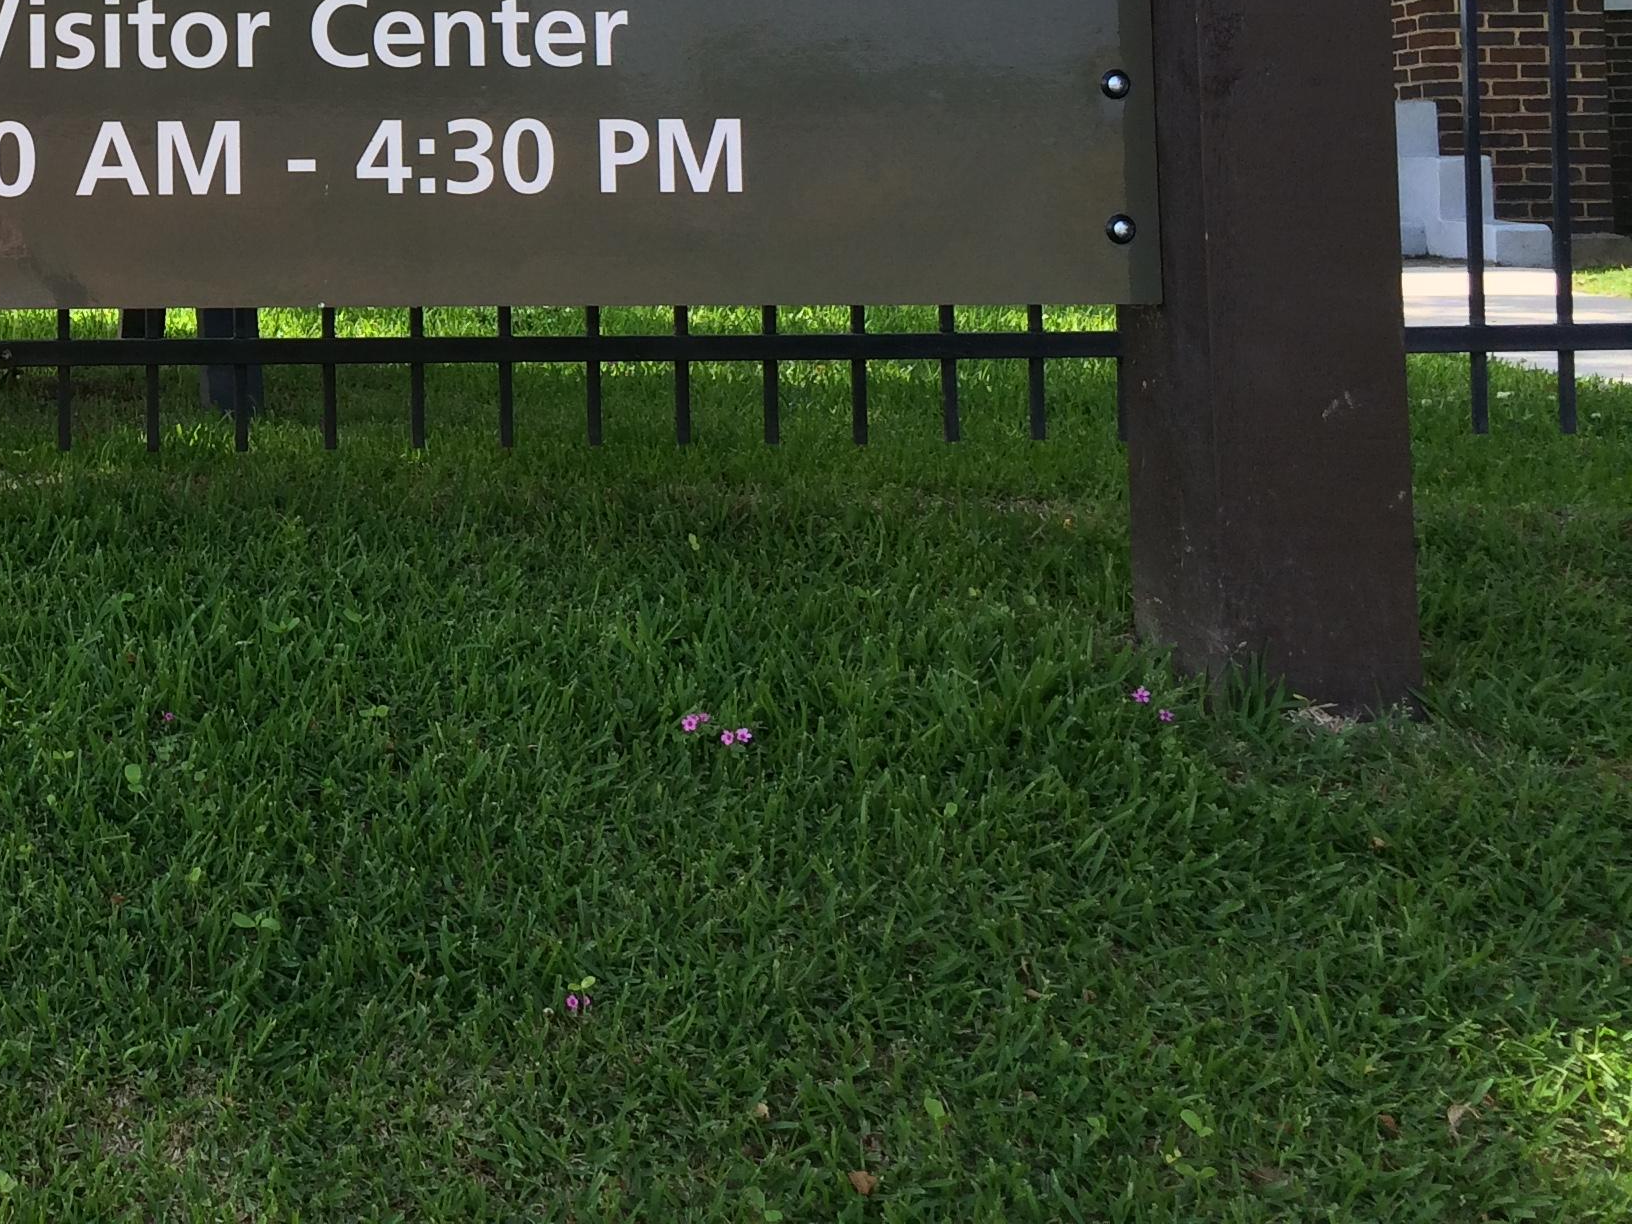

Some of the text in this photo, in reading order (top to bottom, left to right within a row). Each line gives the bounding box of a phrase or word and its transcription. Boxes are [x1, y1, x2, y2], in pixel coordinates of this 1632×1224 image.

[76, 119, 242, 197] AM
[287, 158, 317, 173] -
[356, 118, 555, 196] 4:30
[599, 118, 744, 194] PM
